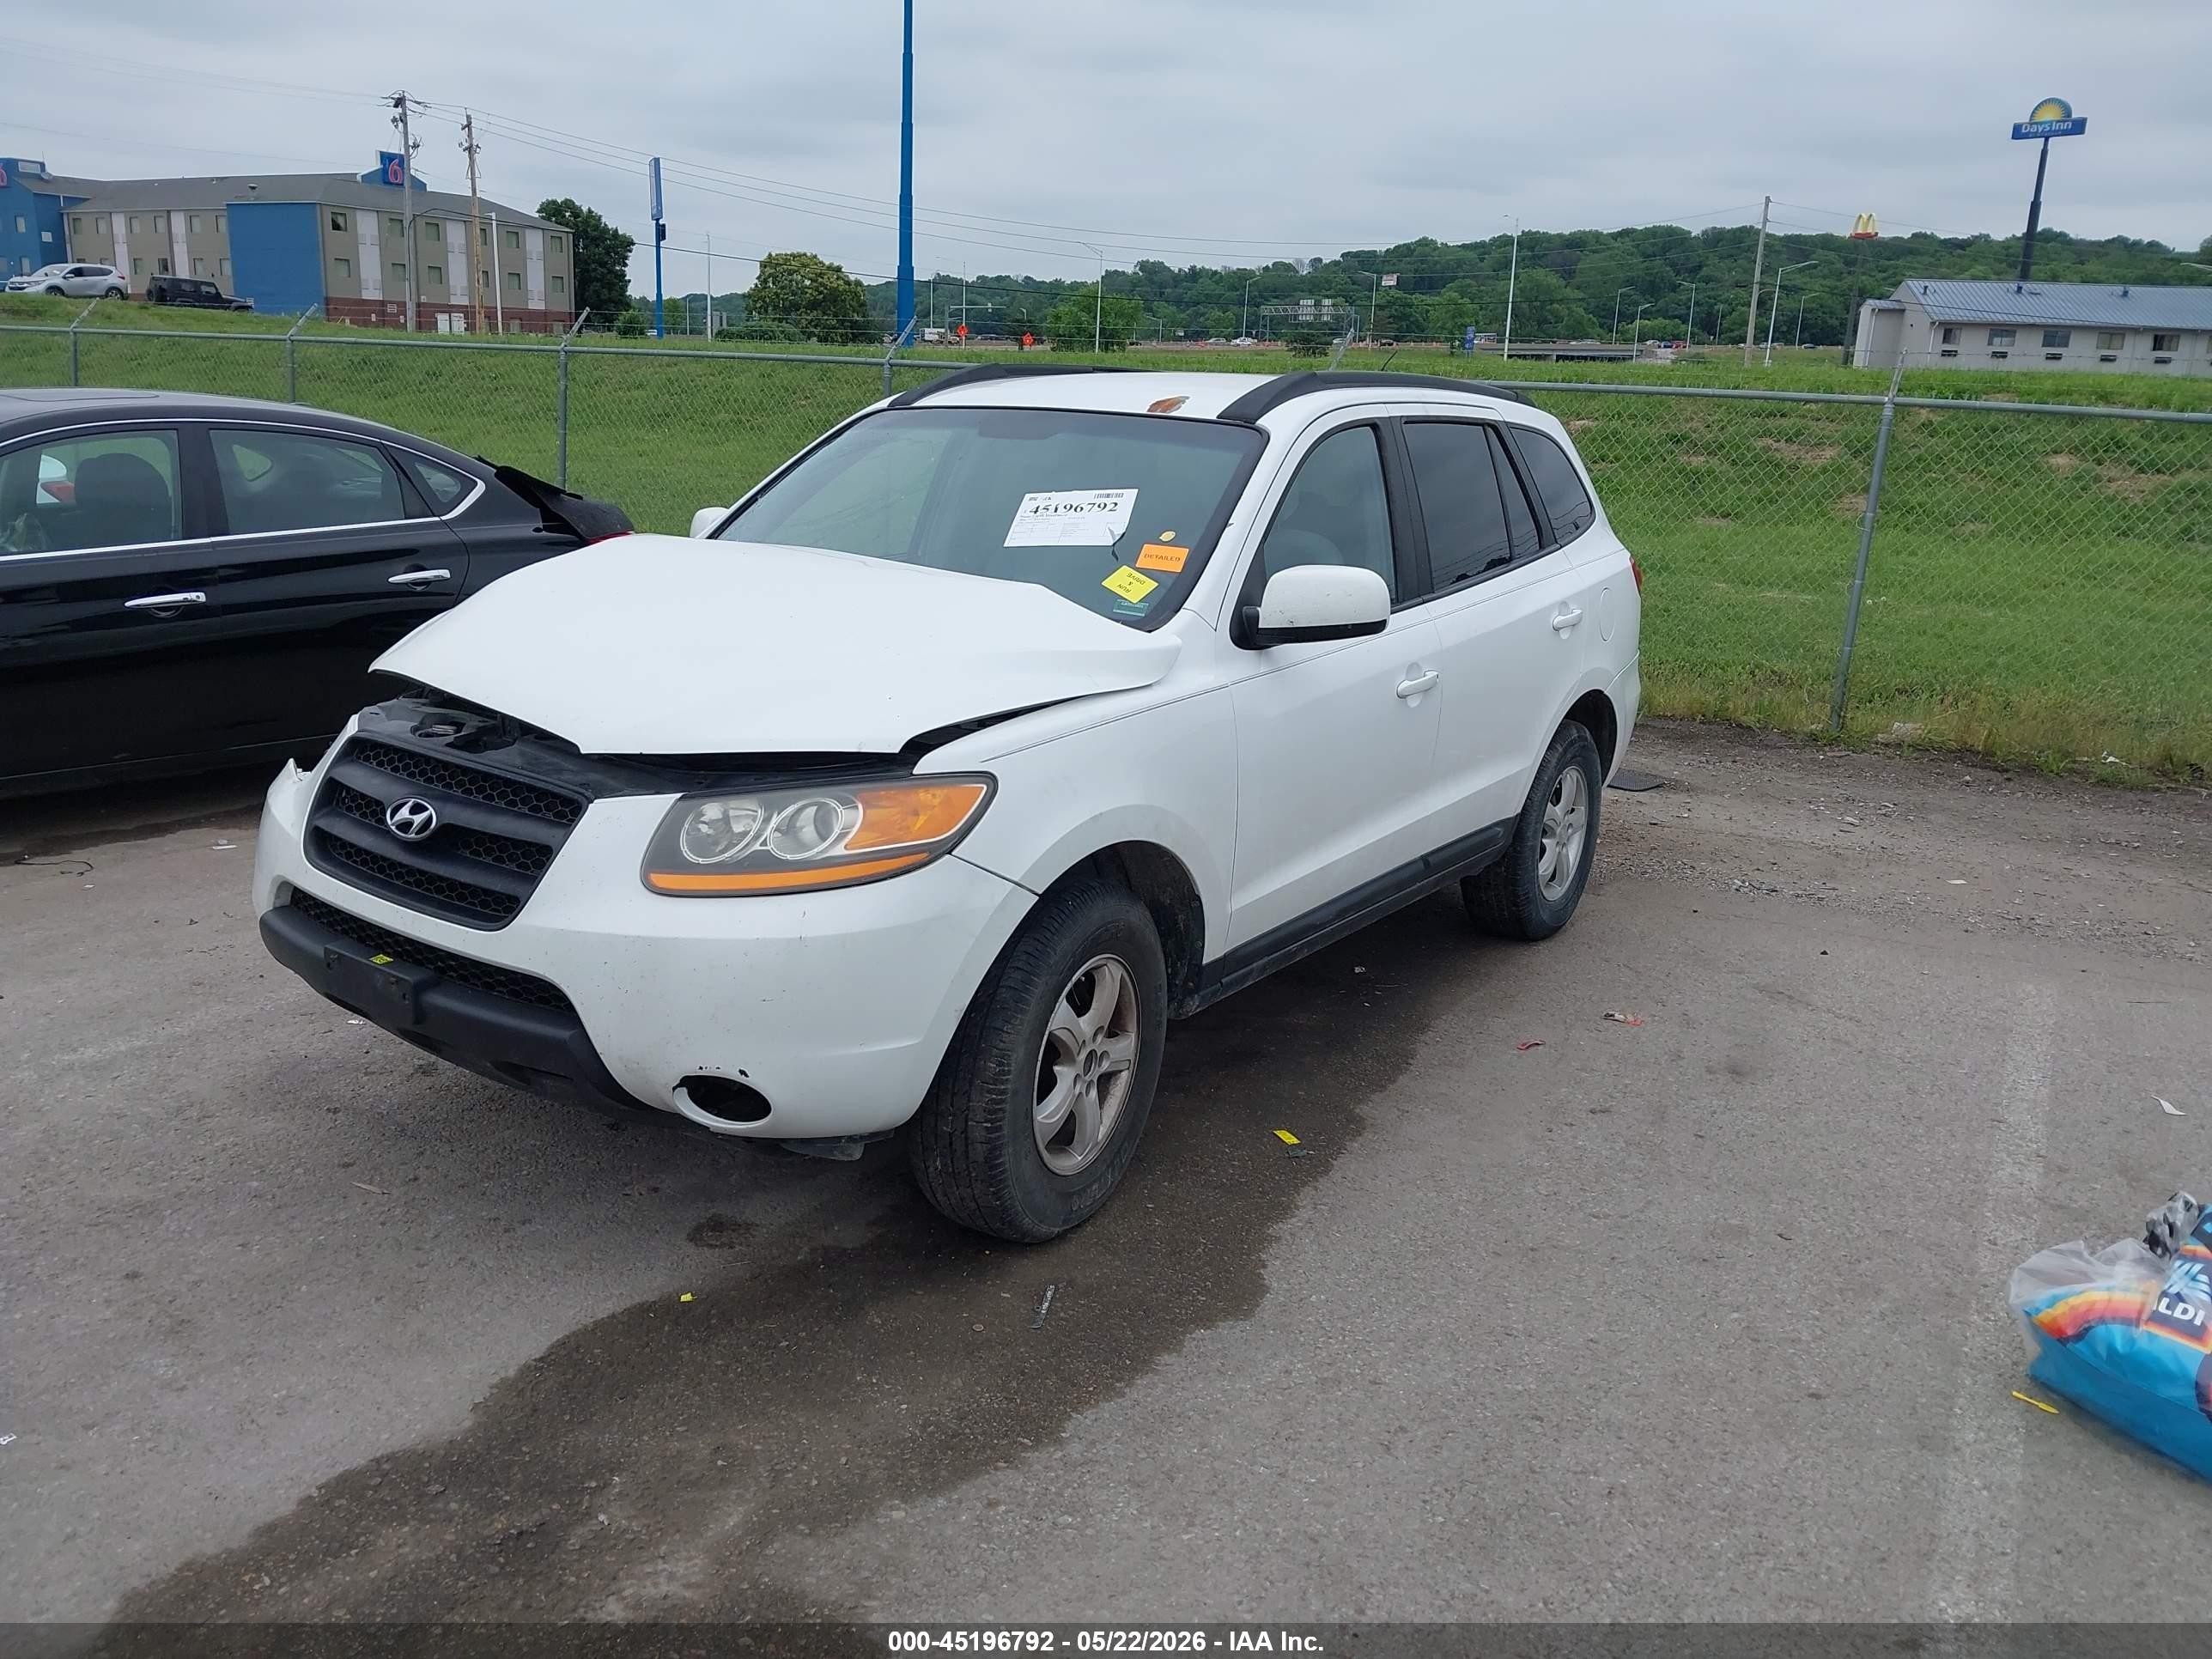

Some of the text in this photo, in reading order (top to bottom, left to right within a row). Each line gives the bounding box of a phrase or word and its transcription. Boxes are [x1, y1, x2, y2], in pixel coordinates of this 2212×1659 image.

[2022, 121, 2072, 133] Days Inn
[388, 158, 404, 184] 6
[1030, 502, 1119, 514] 45196792
[1144, 554, 1181, 562] DETAILED
[1127, 573, 1146, 585] DRIVE
[1117, 584, 1132, 593] RUN
